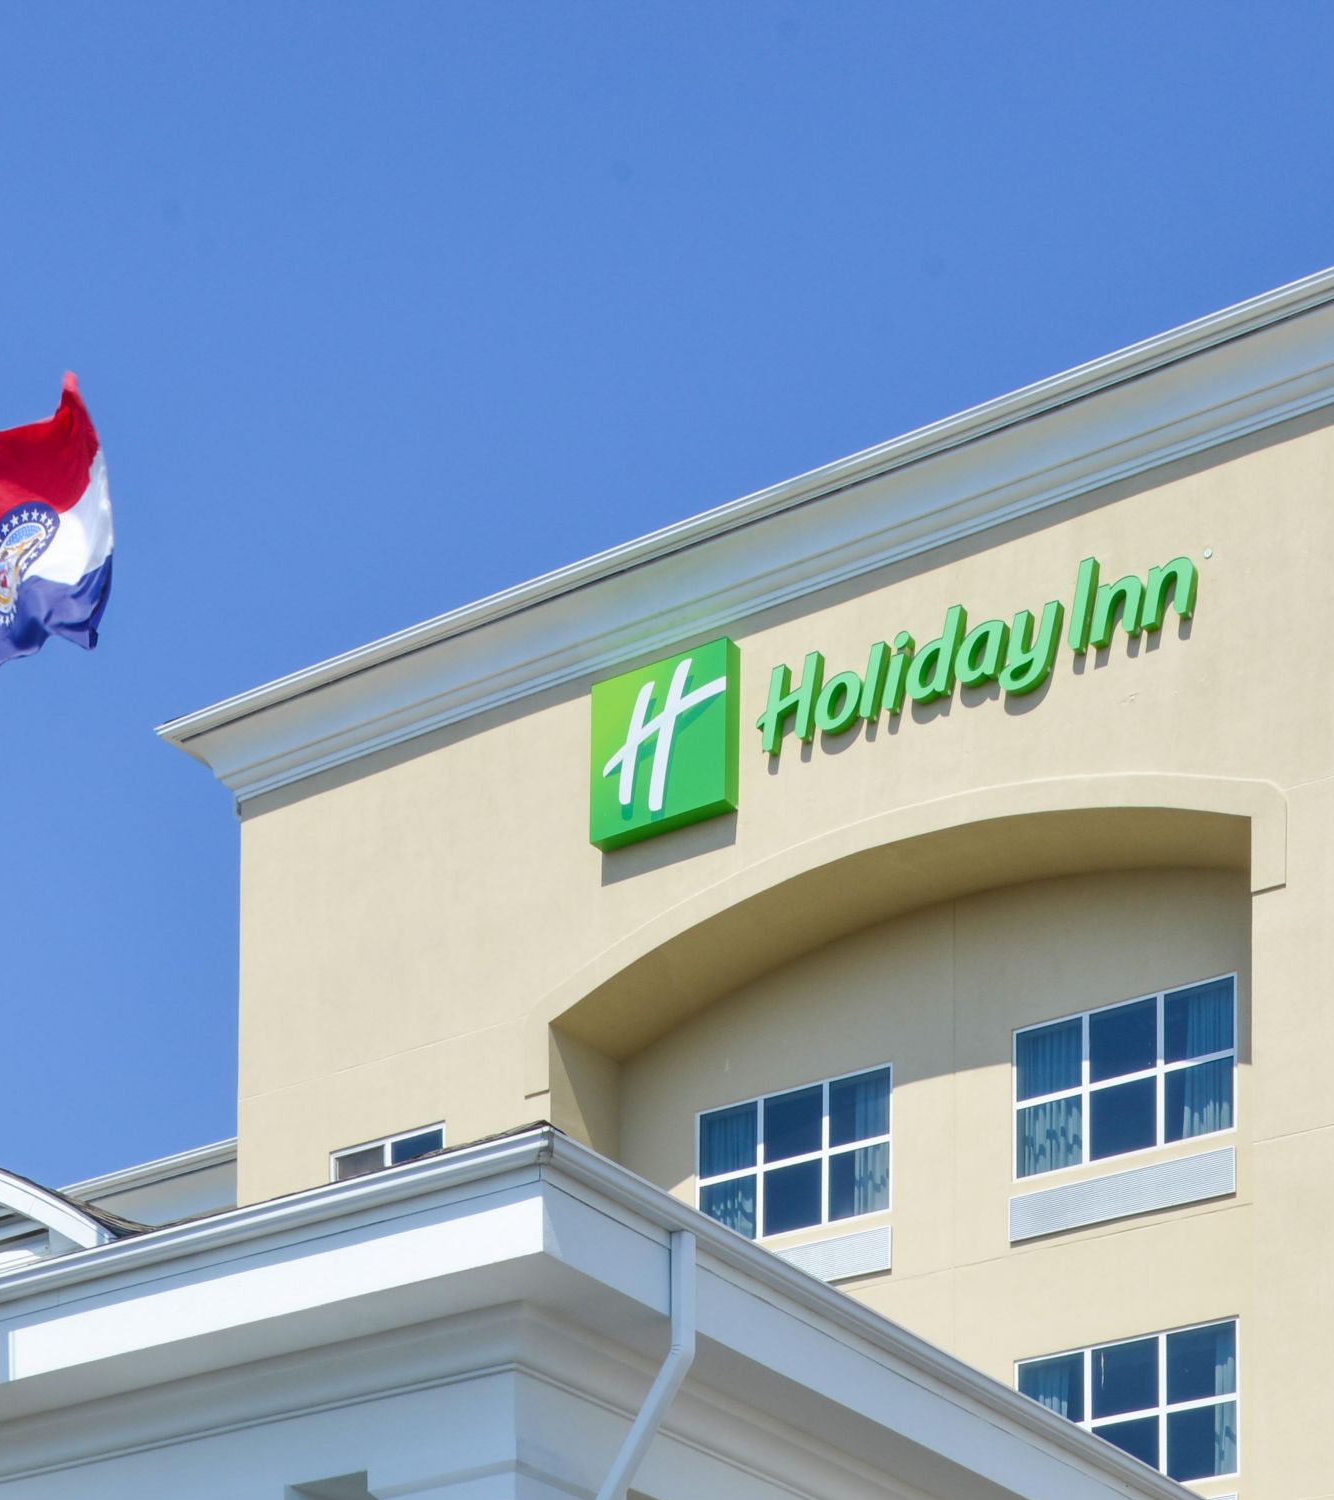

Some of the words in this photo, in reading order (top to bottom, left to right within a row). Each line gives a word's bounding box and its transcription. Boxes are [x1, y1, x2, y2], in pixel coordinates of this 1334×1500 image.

[603, 658, 727, 812] H
[756, 600, 1064, 756] Holiday
[1067, 556, 1198, 656] Inn
